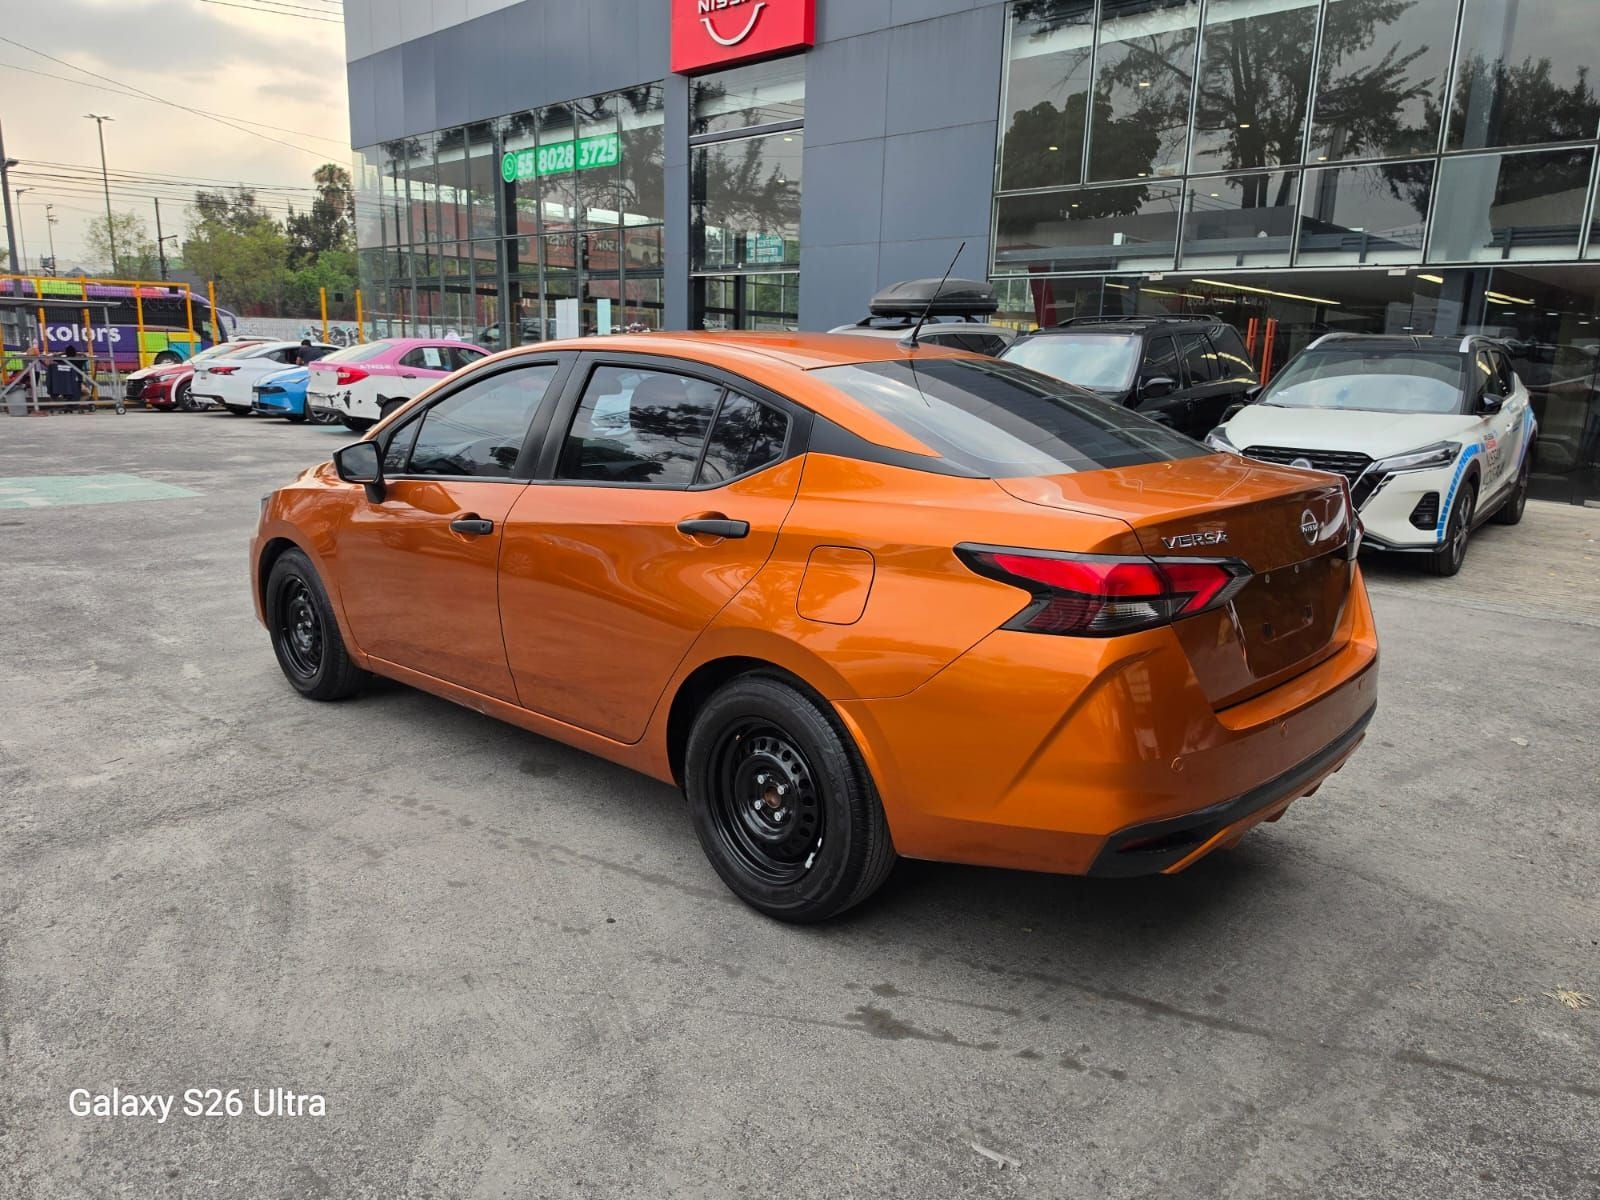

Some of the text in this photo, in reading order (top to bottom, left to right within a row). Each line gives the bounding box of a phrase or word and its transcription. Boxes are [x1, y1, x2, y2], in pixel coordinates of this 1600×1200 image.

[517, 136, 618, 176] 55 8028 3725
[38, 323, 121, 342] kolors
[1161, 530, 1229, 550] VERSA
